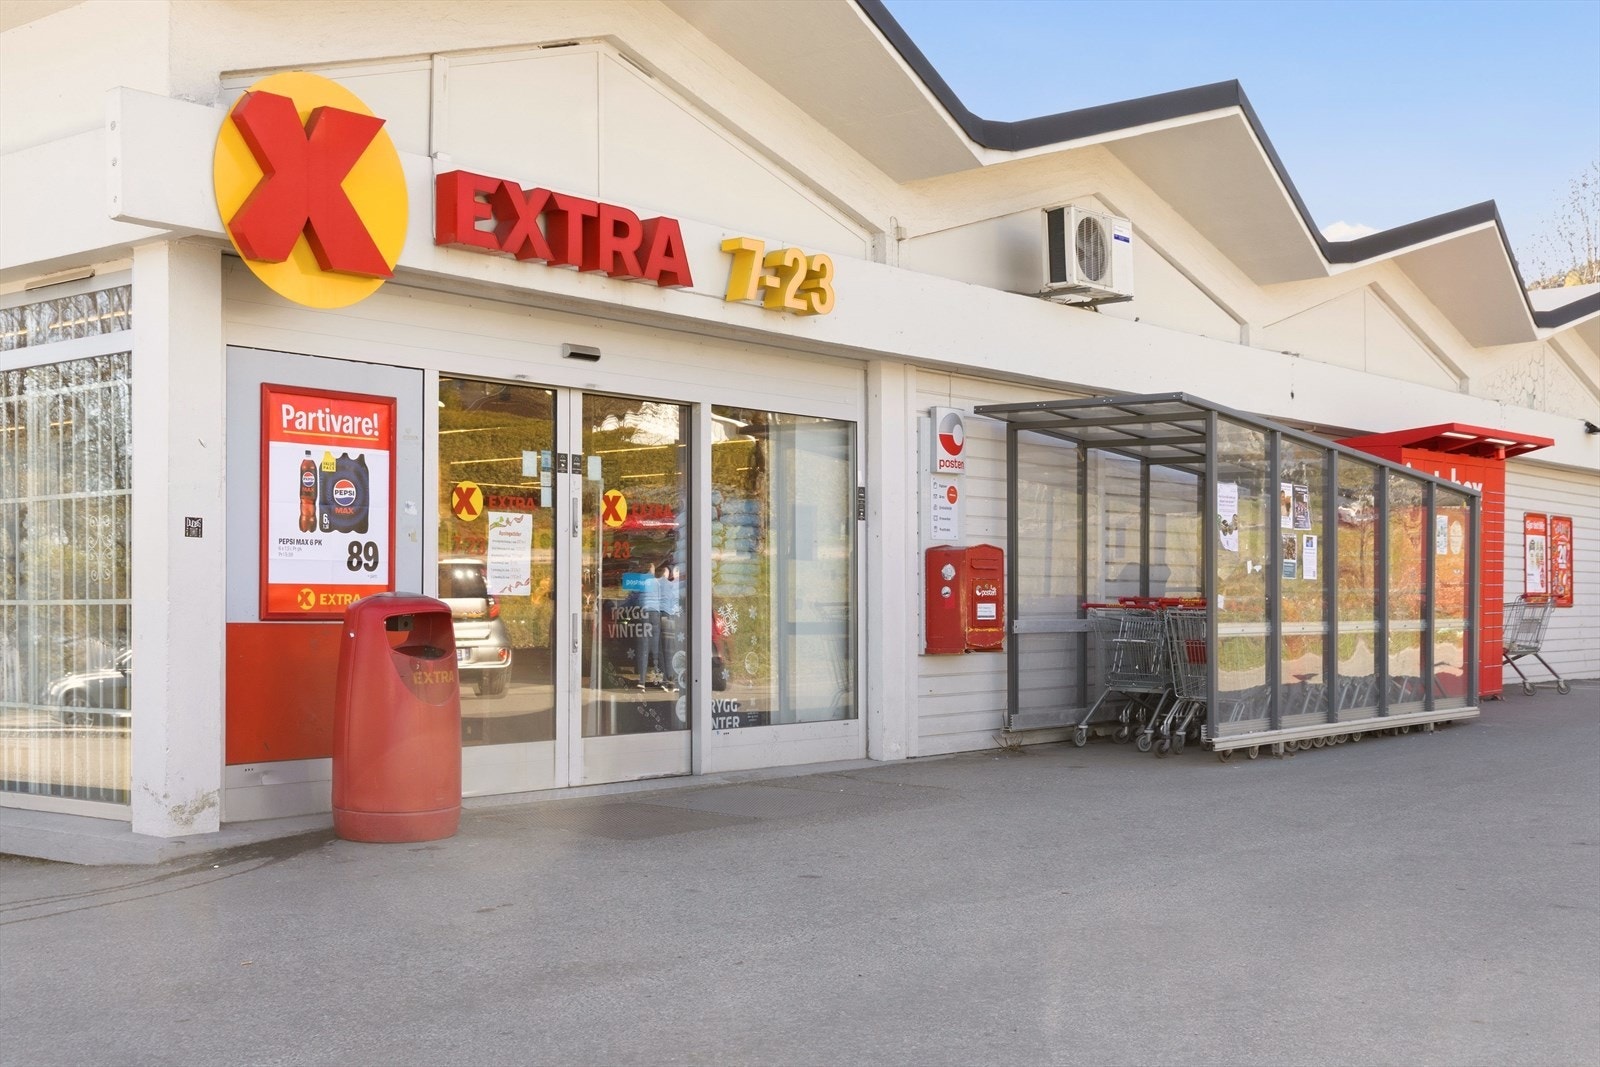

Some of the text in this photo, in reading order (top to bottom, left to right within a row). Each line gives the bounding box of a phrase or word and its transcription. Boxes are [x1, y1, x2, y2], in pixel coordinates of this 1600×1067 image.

[228, 90, 392, 278] X
[436, 169, 694, 288] EXTRA
[721, 236, 835, 317] 7-23
[281, 403, 379, 437] Partivare!
[938, 459, 965, 470] posten
[334, 489, 355, 497] PEPSI
[487, 494, 536, 511] EXTRA
[278, 537, 295, 546] PEPSI
[296, 538, 309, 546] MAX
[347, 540, 379, 572] 89
[319, 593, 362, 606] EXTRA
[610, 605, 650, 621] TRYGG
[607, 623, 653, 639] VINTER
[413, 671, 456, 685] EXTRA
[712, 698, 738, 713] RYGG
